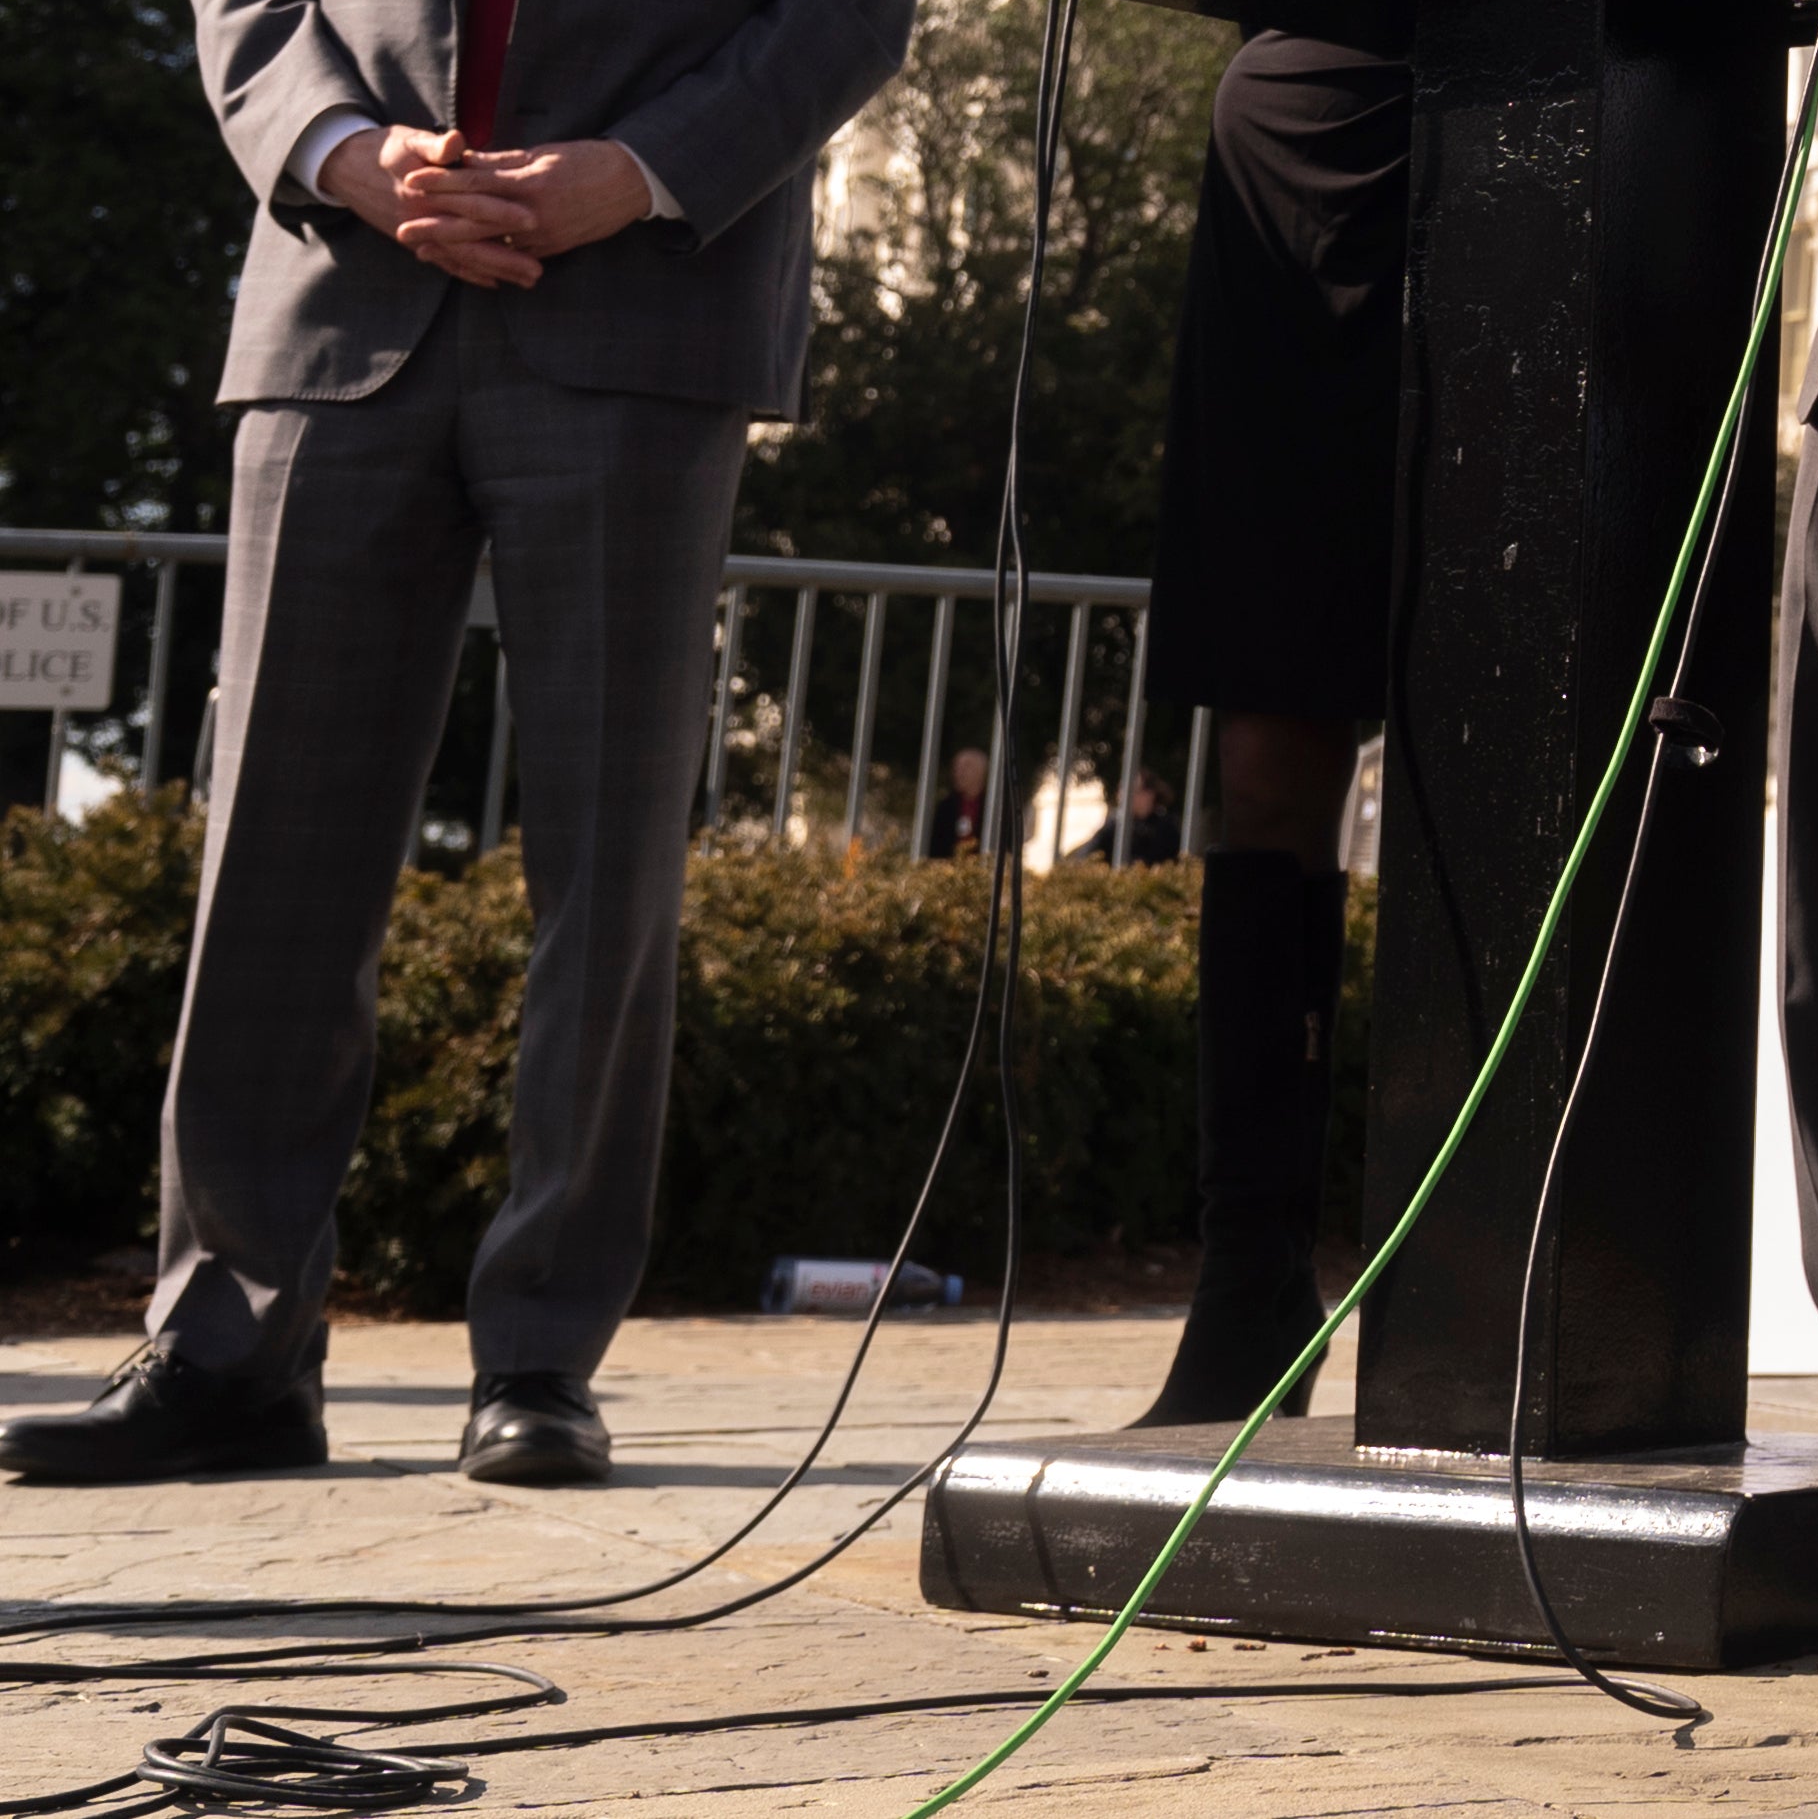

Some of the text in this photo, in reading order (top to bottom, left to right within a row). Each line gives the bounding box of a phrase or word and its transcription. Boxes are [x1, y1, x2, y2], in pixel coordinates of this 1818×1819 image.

[0, 597, 110, 632] F U.S.
[0, 648, 94, 683] LICE
[811, 1280, 869, 1301] evian
